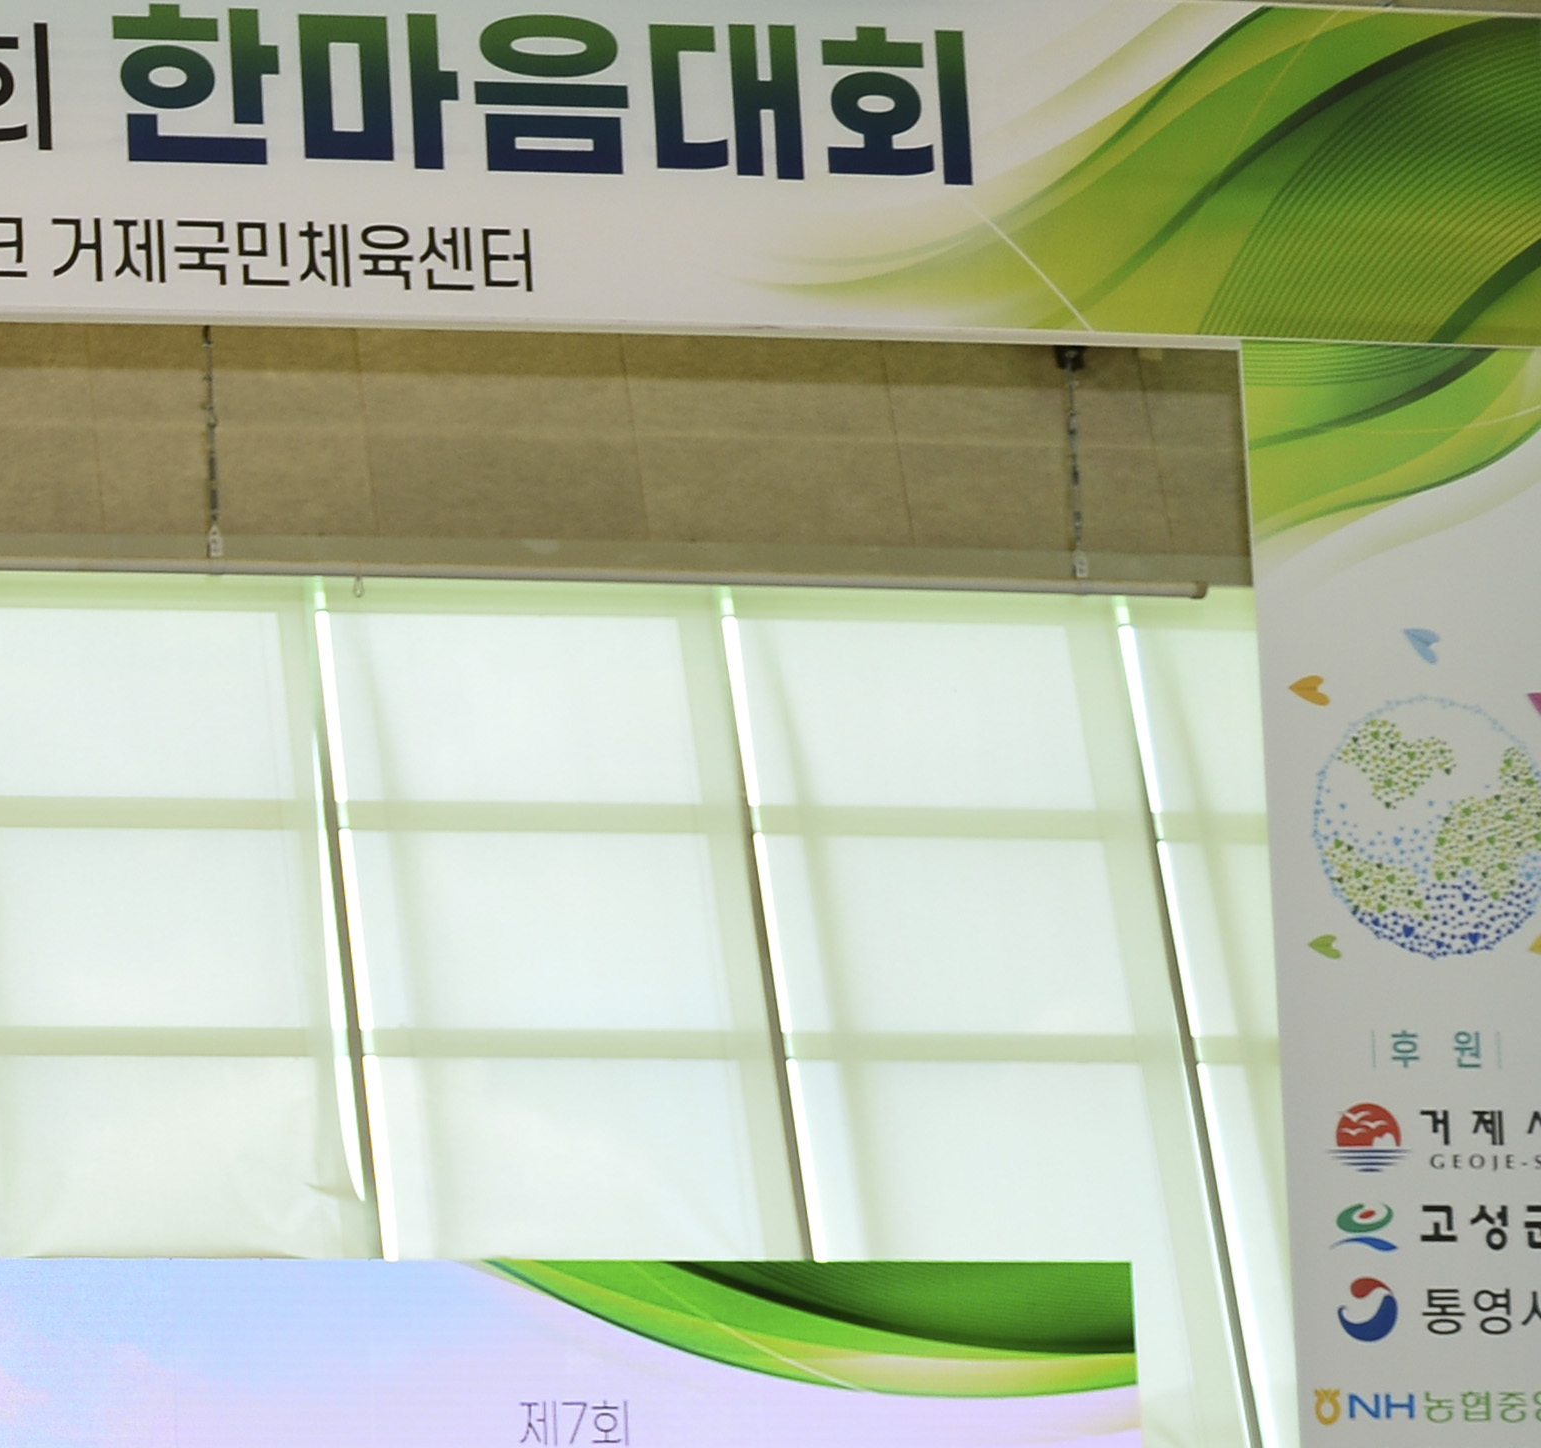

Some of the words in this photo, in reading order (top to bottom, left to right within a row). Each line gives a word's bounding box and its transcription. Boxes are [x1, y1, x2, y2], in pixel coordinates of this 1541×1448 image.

[112, 3, 974, 186] 한마음대회
[51, 218, 534, 293] 거제국민체육센터
[519, 1400, 630, 1447] 제7회
